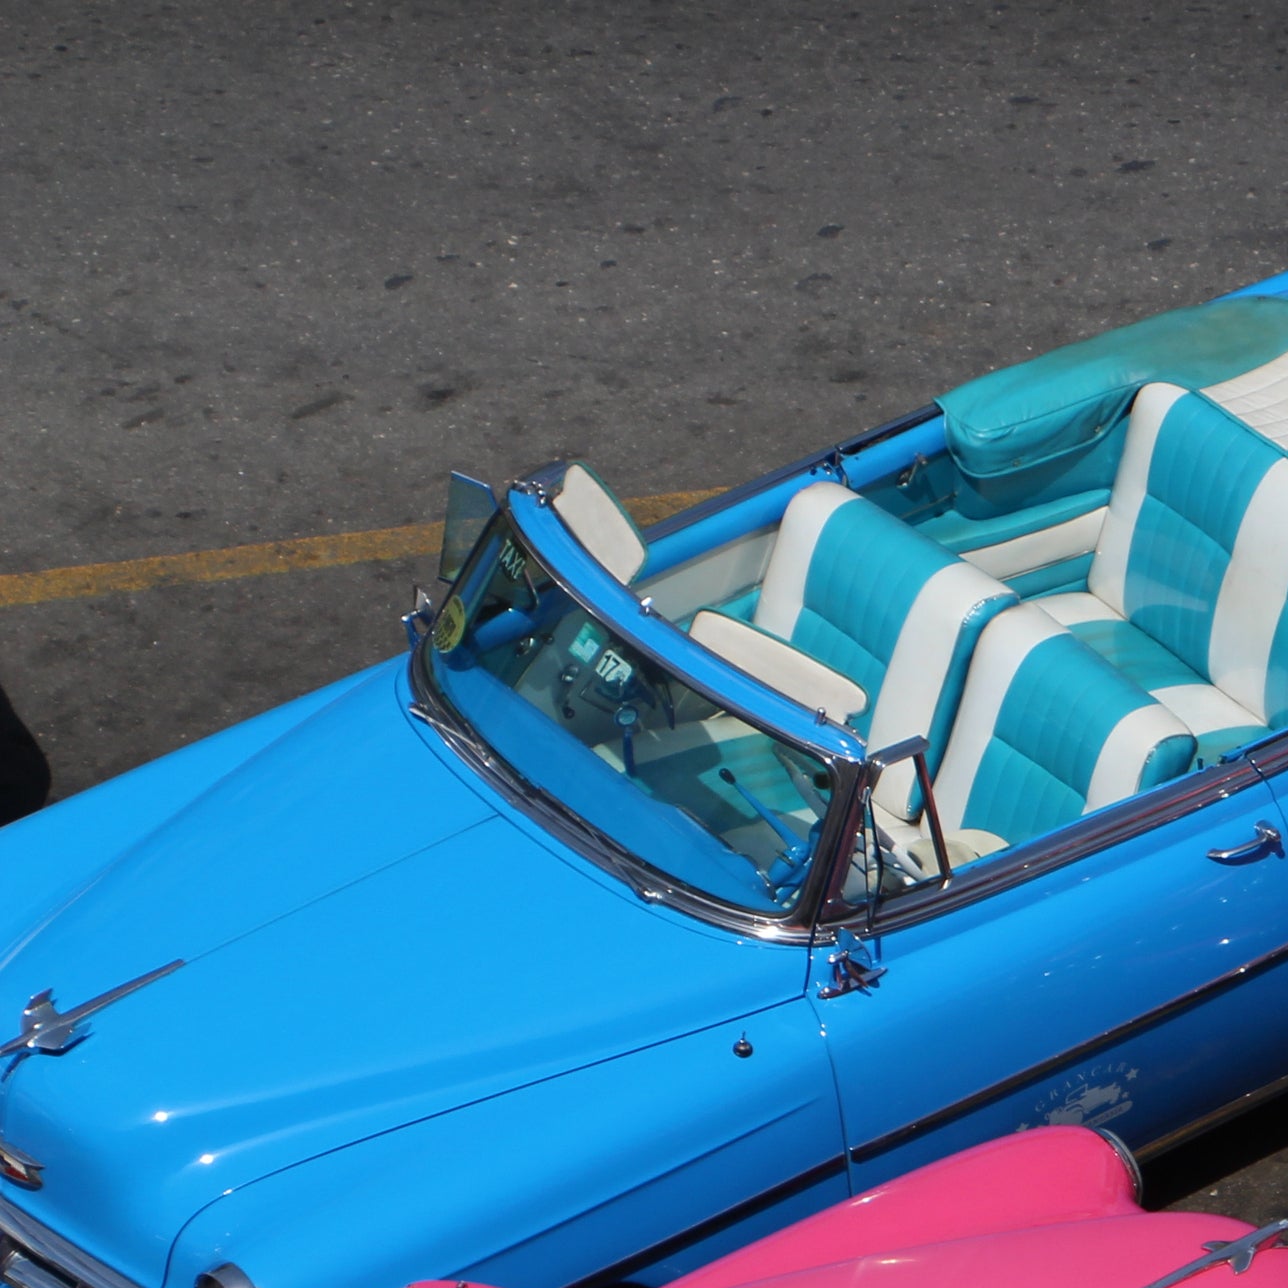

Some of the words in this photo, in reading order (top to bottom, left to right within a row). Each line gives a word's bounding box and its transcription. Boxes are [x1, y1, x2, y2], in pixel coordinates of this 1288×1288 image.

[499, 538, 526, 580] TAXI
[598, 653, 620, 682] 17
[1035, 1062, 1128, 1112] GRANCAR
